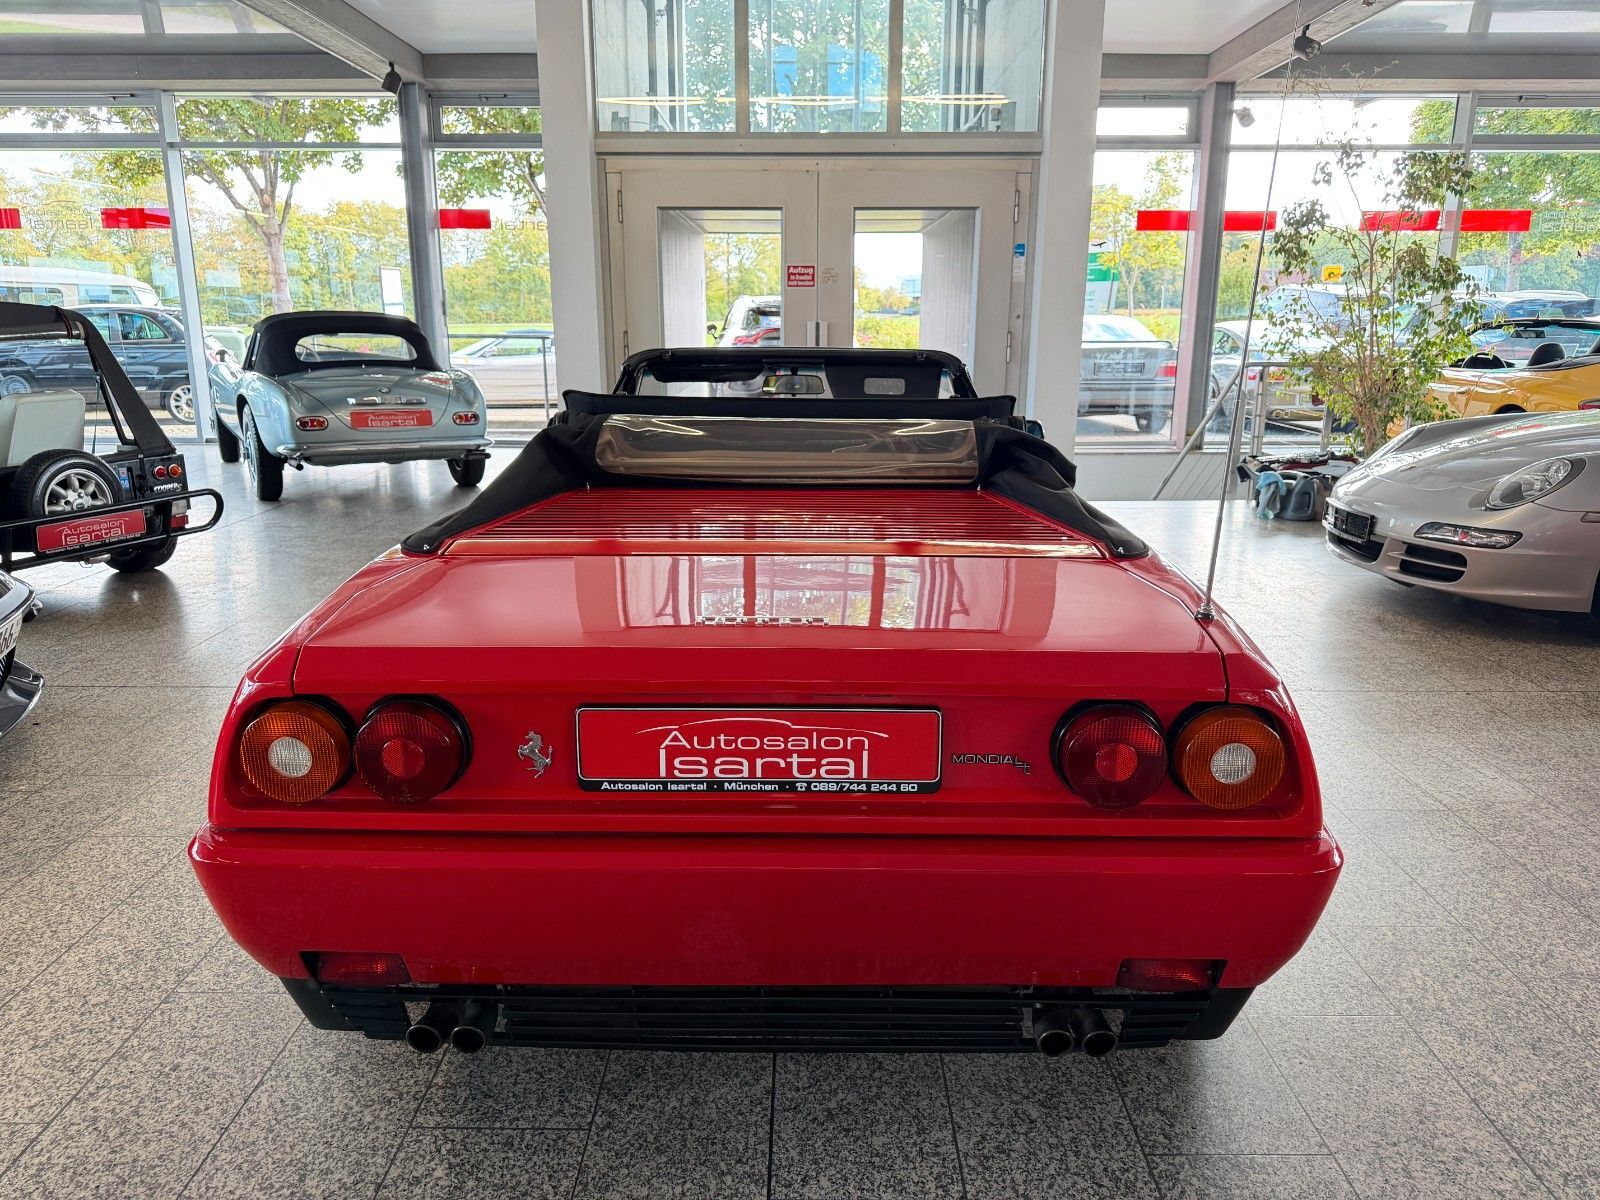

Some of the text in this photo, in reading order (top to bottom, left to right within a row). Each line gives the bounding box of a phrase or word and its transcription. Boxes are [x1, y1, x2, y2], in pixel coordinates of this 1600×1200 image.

[789, 266, 813, 274] Aufzug
[62, 520, 125, 535] Autosalon
[62, 526, 126, 546] Isartal
[660, 731, 869, 750] Autosalon
[659, 748, 869, 778] Isartal
[600, 781, 918, 792] Autosalon Isartal München 089/744 244 60
